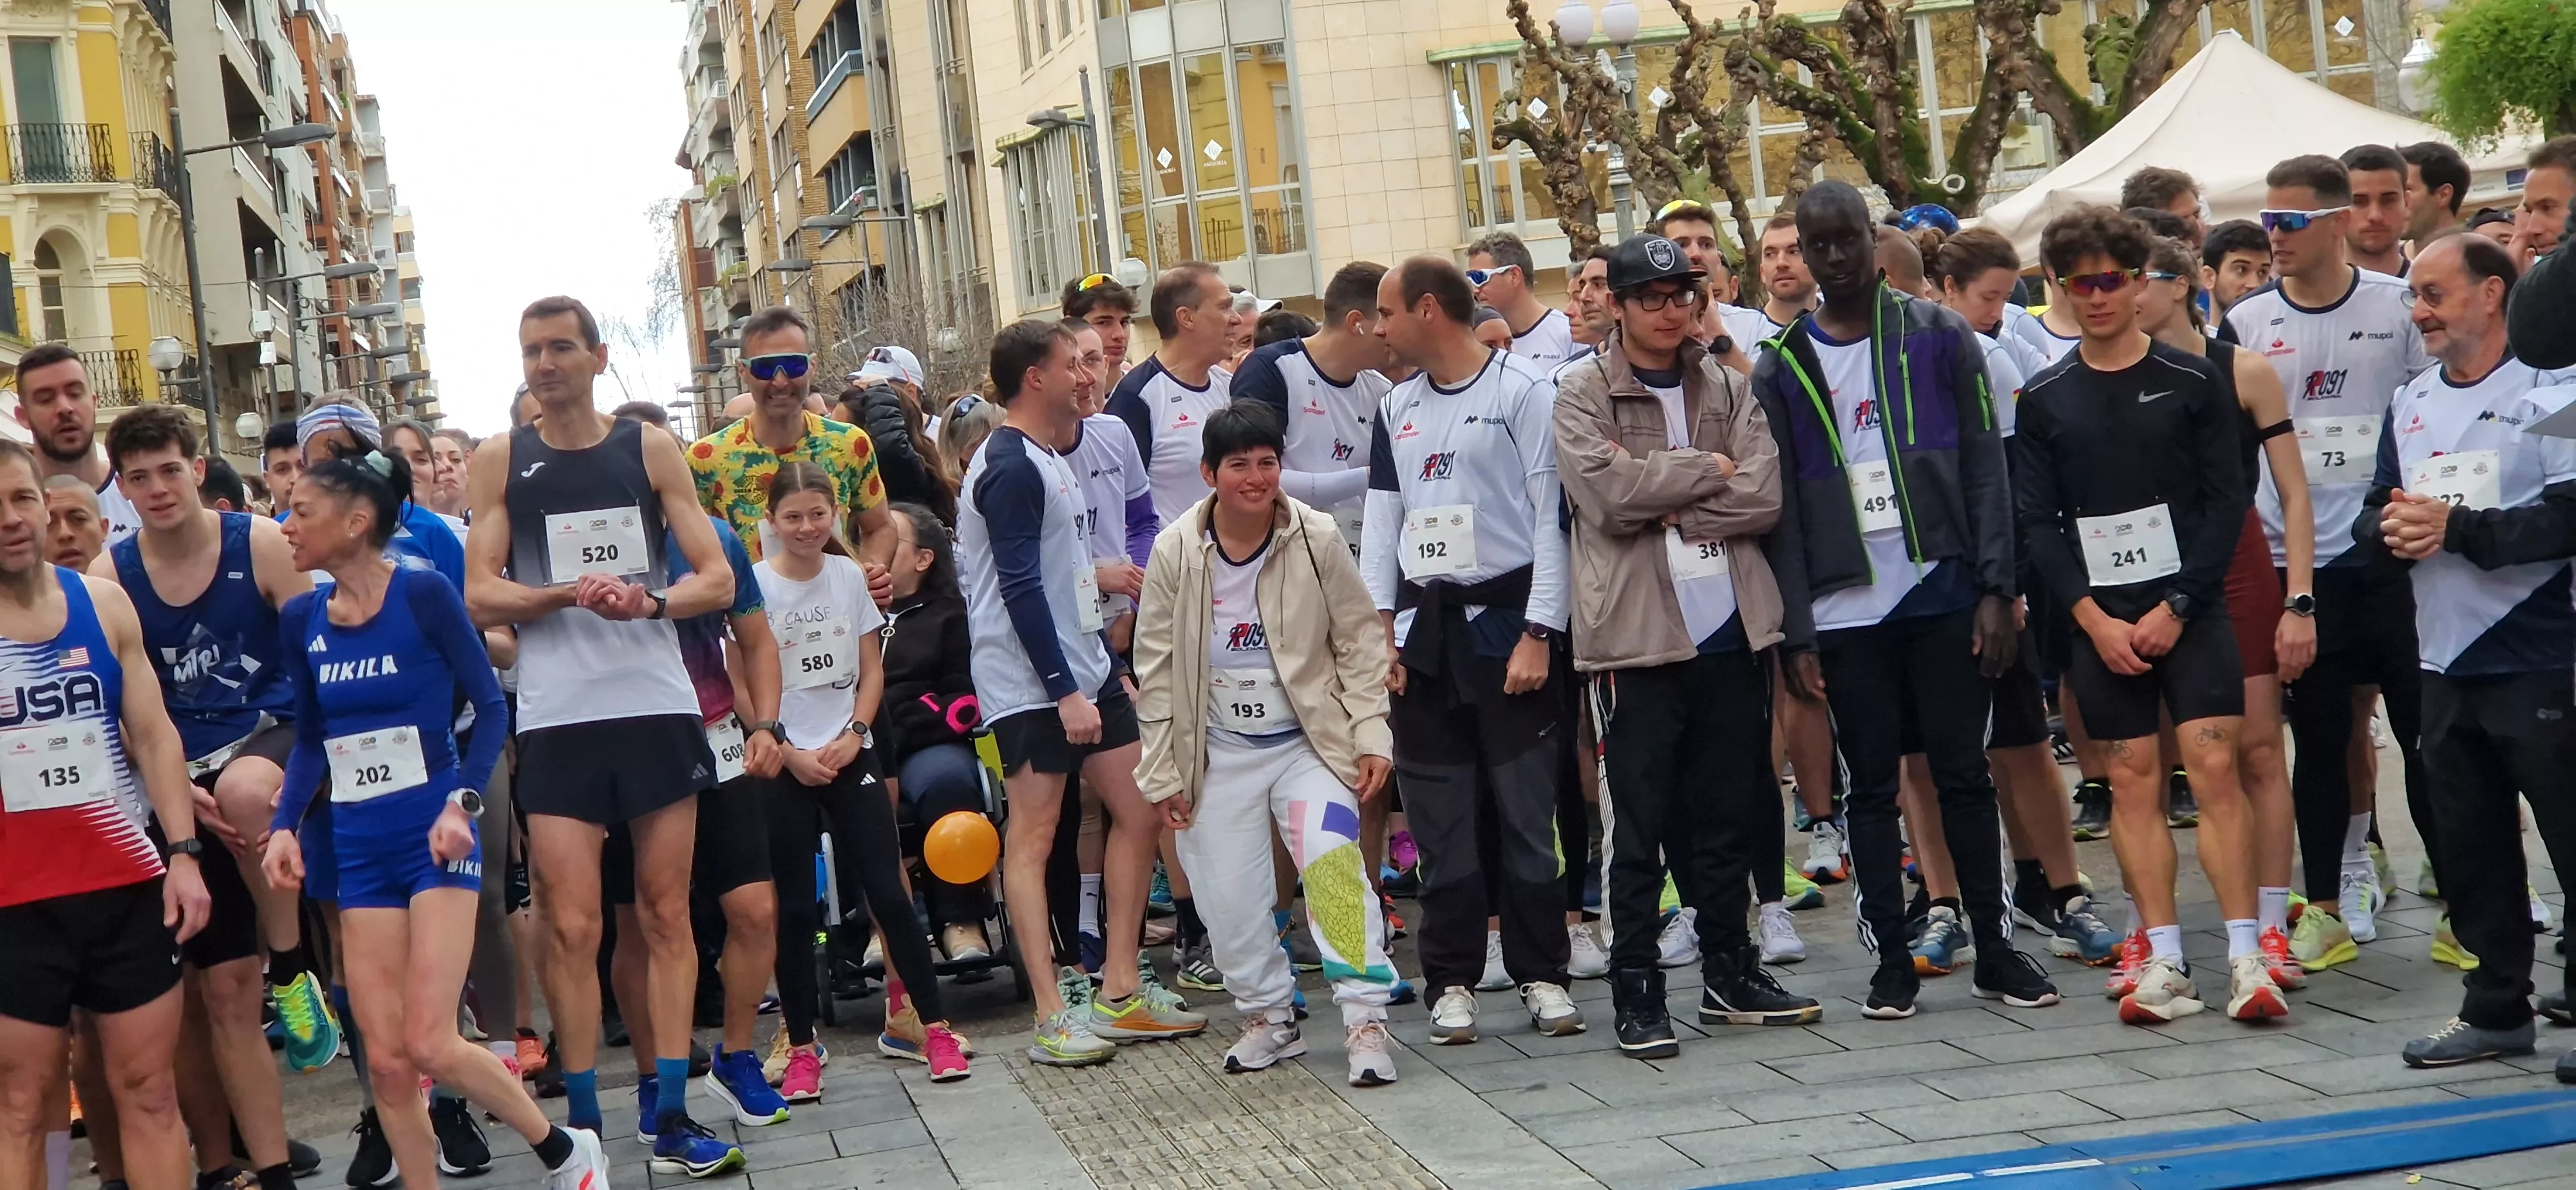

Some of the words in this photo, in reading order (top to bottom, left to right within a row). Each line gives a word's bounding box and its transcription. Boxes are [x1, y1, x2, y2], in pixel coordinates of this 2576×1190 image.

[2367, 331, 2394, 341] mupol
[2321, 451, 2346, 468] 73
[1864, 494, 1899, 513] 491
[582, 544, 618, 563] 520
[1417, 542, 1448, 559] 192
[1698, 540, 1726, 560] 381
[2111, 547, 2147, 567] 241
[319, 654, 399, 684] BIKILA
[801, 653, 834, 673] 580
[1230, 703, 1265, 719] 193
[39, 766, 80, 788] 135
[355, 764, 392, 787] 202
